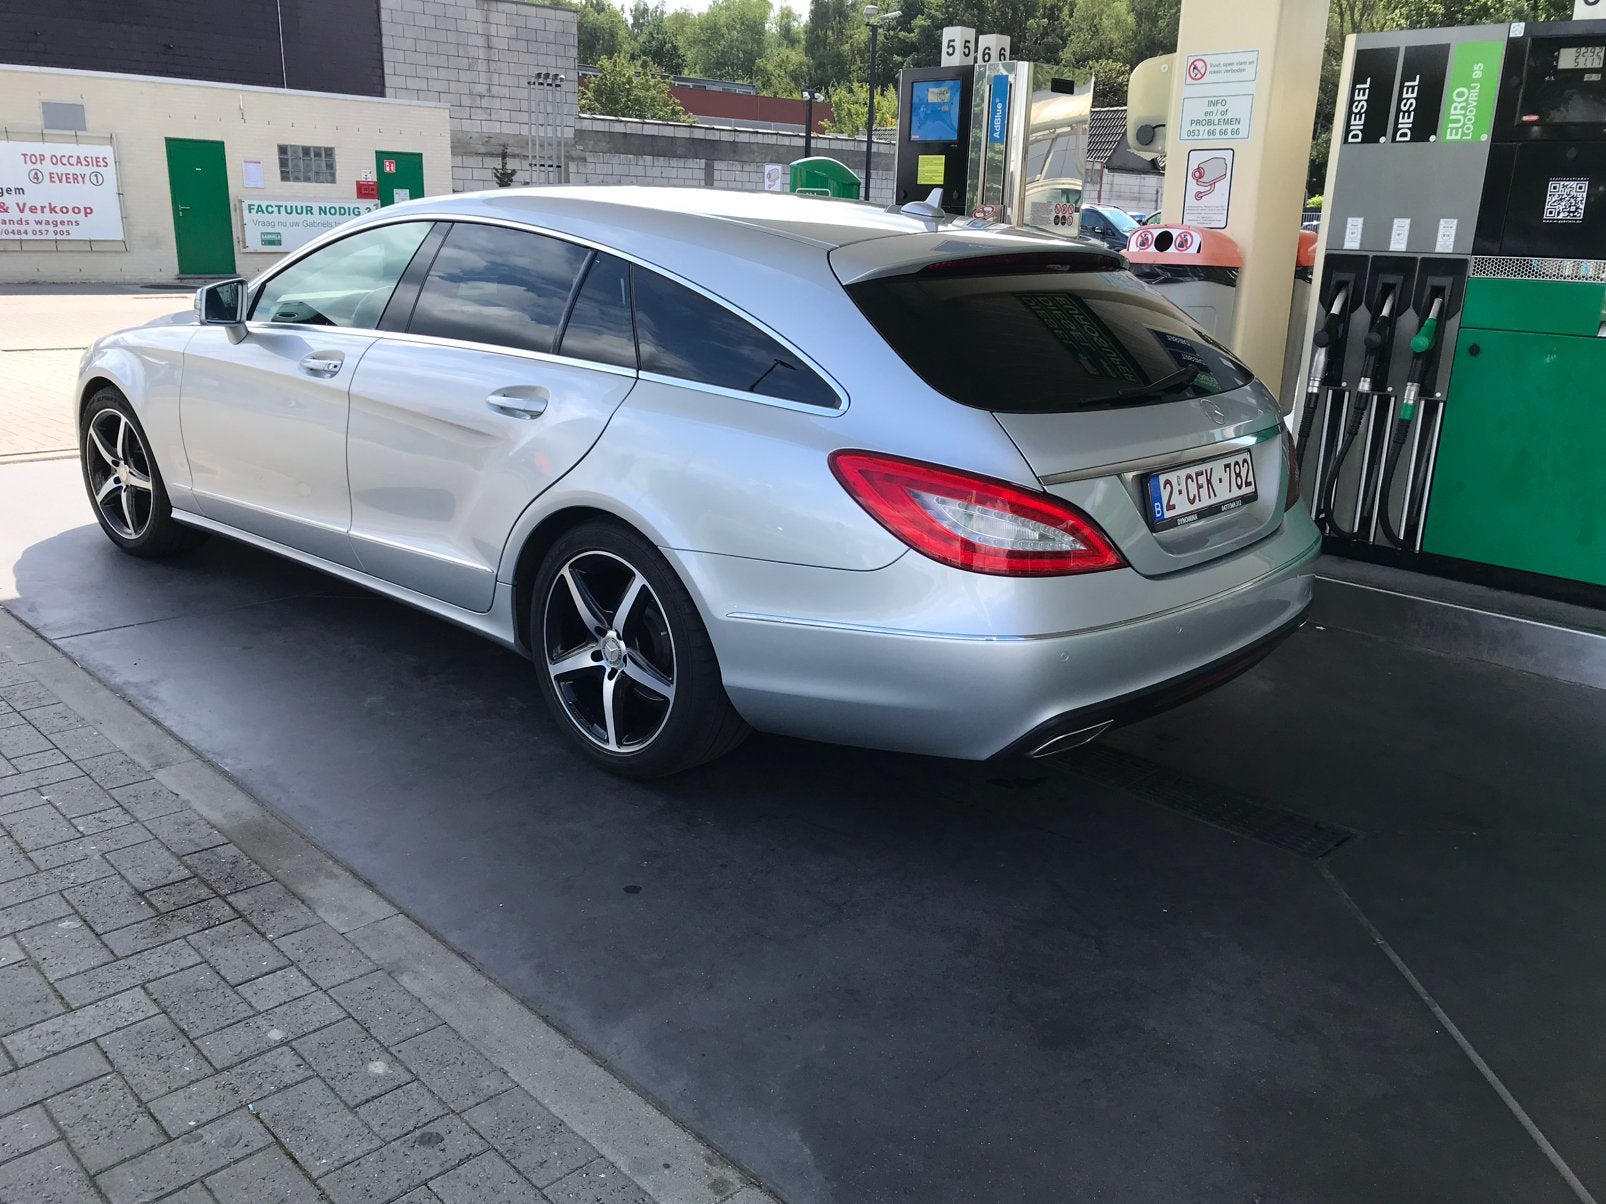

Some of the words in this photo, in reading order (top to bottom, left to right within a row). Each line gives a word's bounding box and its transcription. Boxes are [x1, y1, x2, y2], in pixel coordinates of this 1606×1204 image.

[946, 39, 956, 56] 5
[963, 40, 971, 57] 5
[982, 47, 991, 63] 6
[998, 47, 1006, 62] 6
[1207, 99, 1227, 107] INFO
[1395, 74, 1420, 142] DIESEL
[1462, 83, 1480, 139] LOODVRIJ
[1472, 63, 1484, 79] 95
[1220, 108, 1229, 116] of
[1348, 77, 1371, 143] DIESEL
[1446, 87, 1469, 140] EURO
[1190, 118, 1241, 126] PROBLEMEN
[1186, 129, 1201, 137] 053
[1207, 128, 1217, 136] 66
[1218, 128, 1229, 136] 66
[1230, 127, 1241, 136] 66
[21, 153, 46, 165] TOP
[50, 154, 109, 168] OCCASIES
[49, 172, 87, 184] EVERY
[16, 202, 94, 217] Verkoop
[247, 203, 314, 215] FACTUUR
[318, 205, 361, 216] NODIG
[34, 219, 80, 227] wagens
[253, 219, 275, 228] Vraag
[1154, 502, 1162, 517] B
